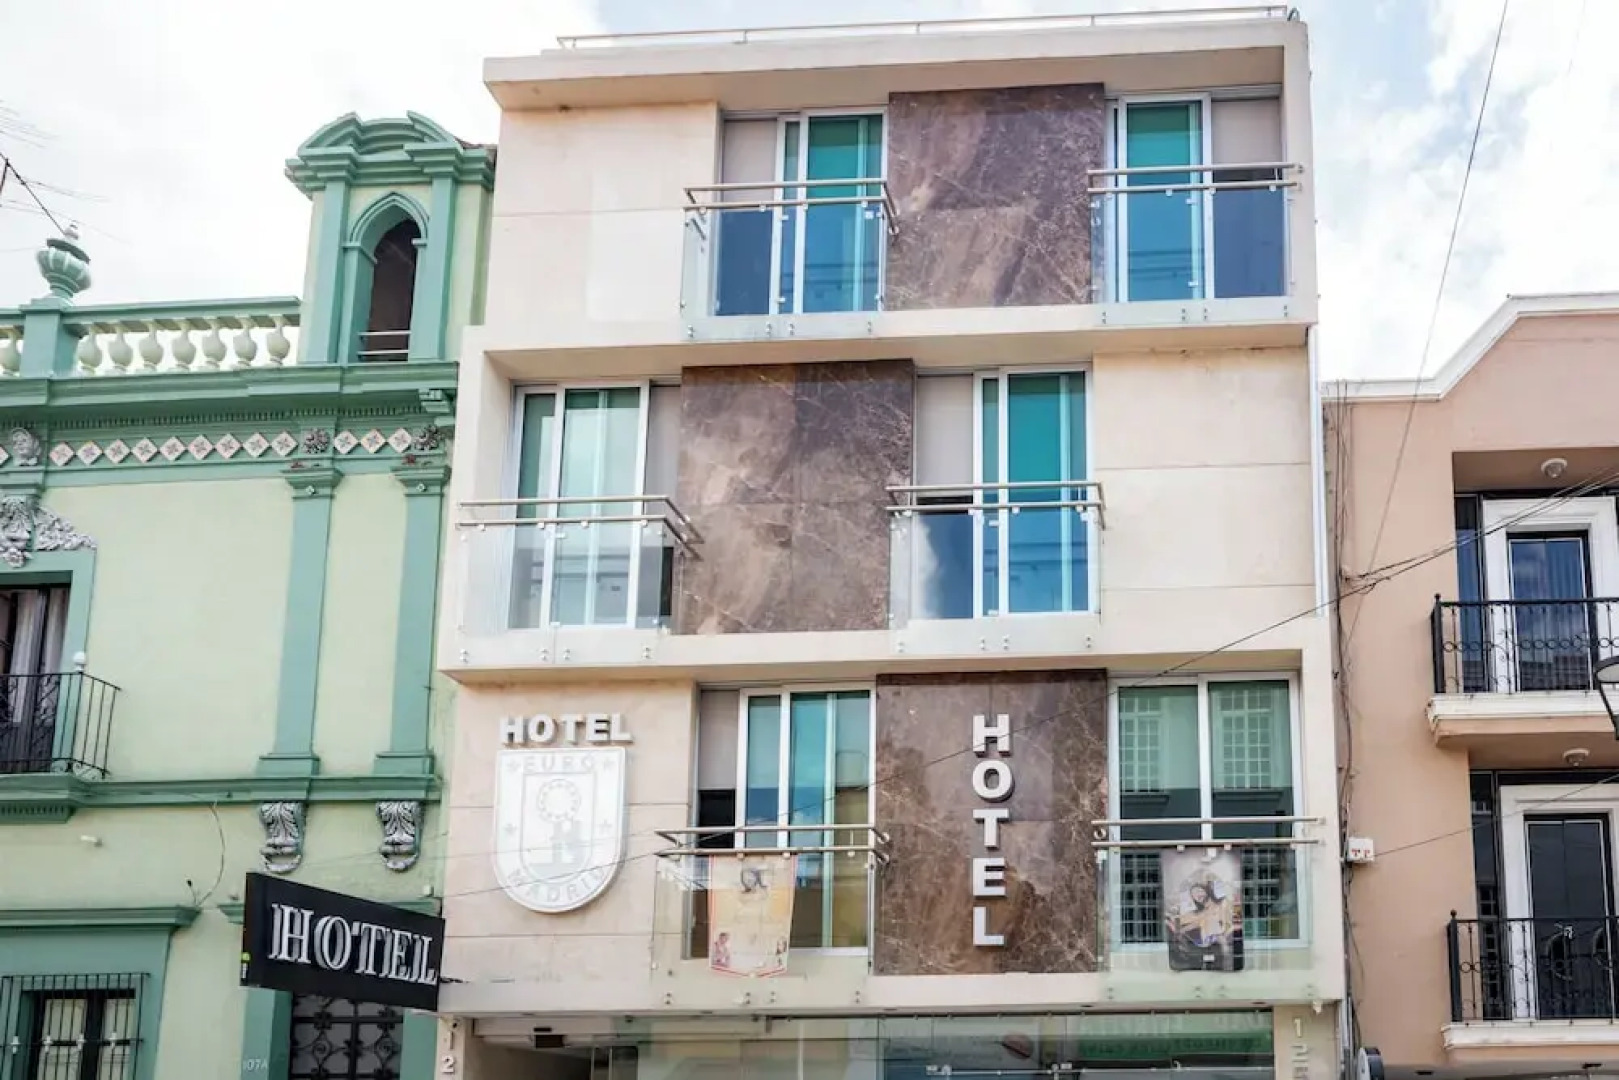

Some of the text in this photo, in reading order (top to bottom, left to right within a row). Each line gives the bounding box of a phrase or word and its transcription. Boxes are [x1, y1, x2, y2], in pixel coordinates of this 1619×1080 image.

[500, 712, 633, 745] HOTEL
[522, 753, 595, 773] EURO
[972, 713, 1014, 947] HOTEL
[506, 866, 608, 903] MADRID
[268, 902, 438, 986] HOTEL
